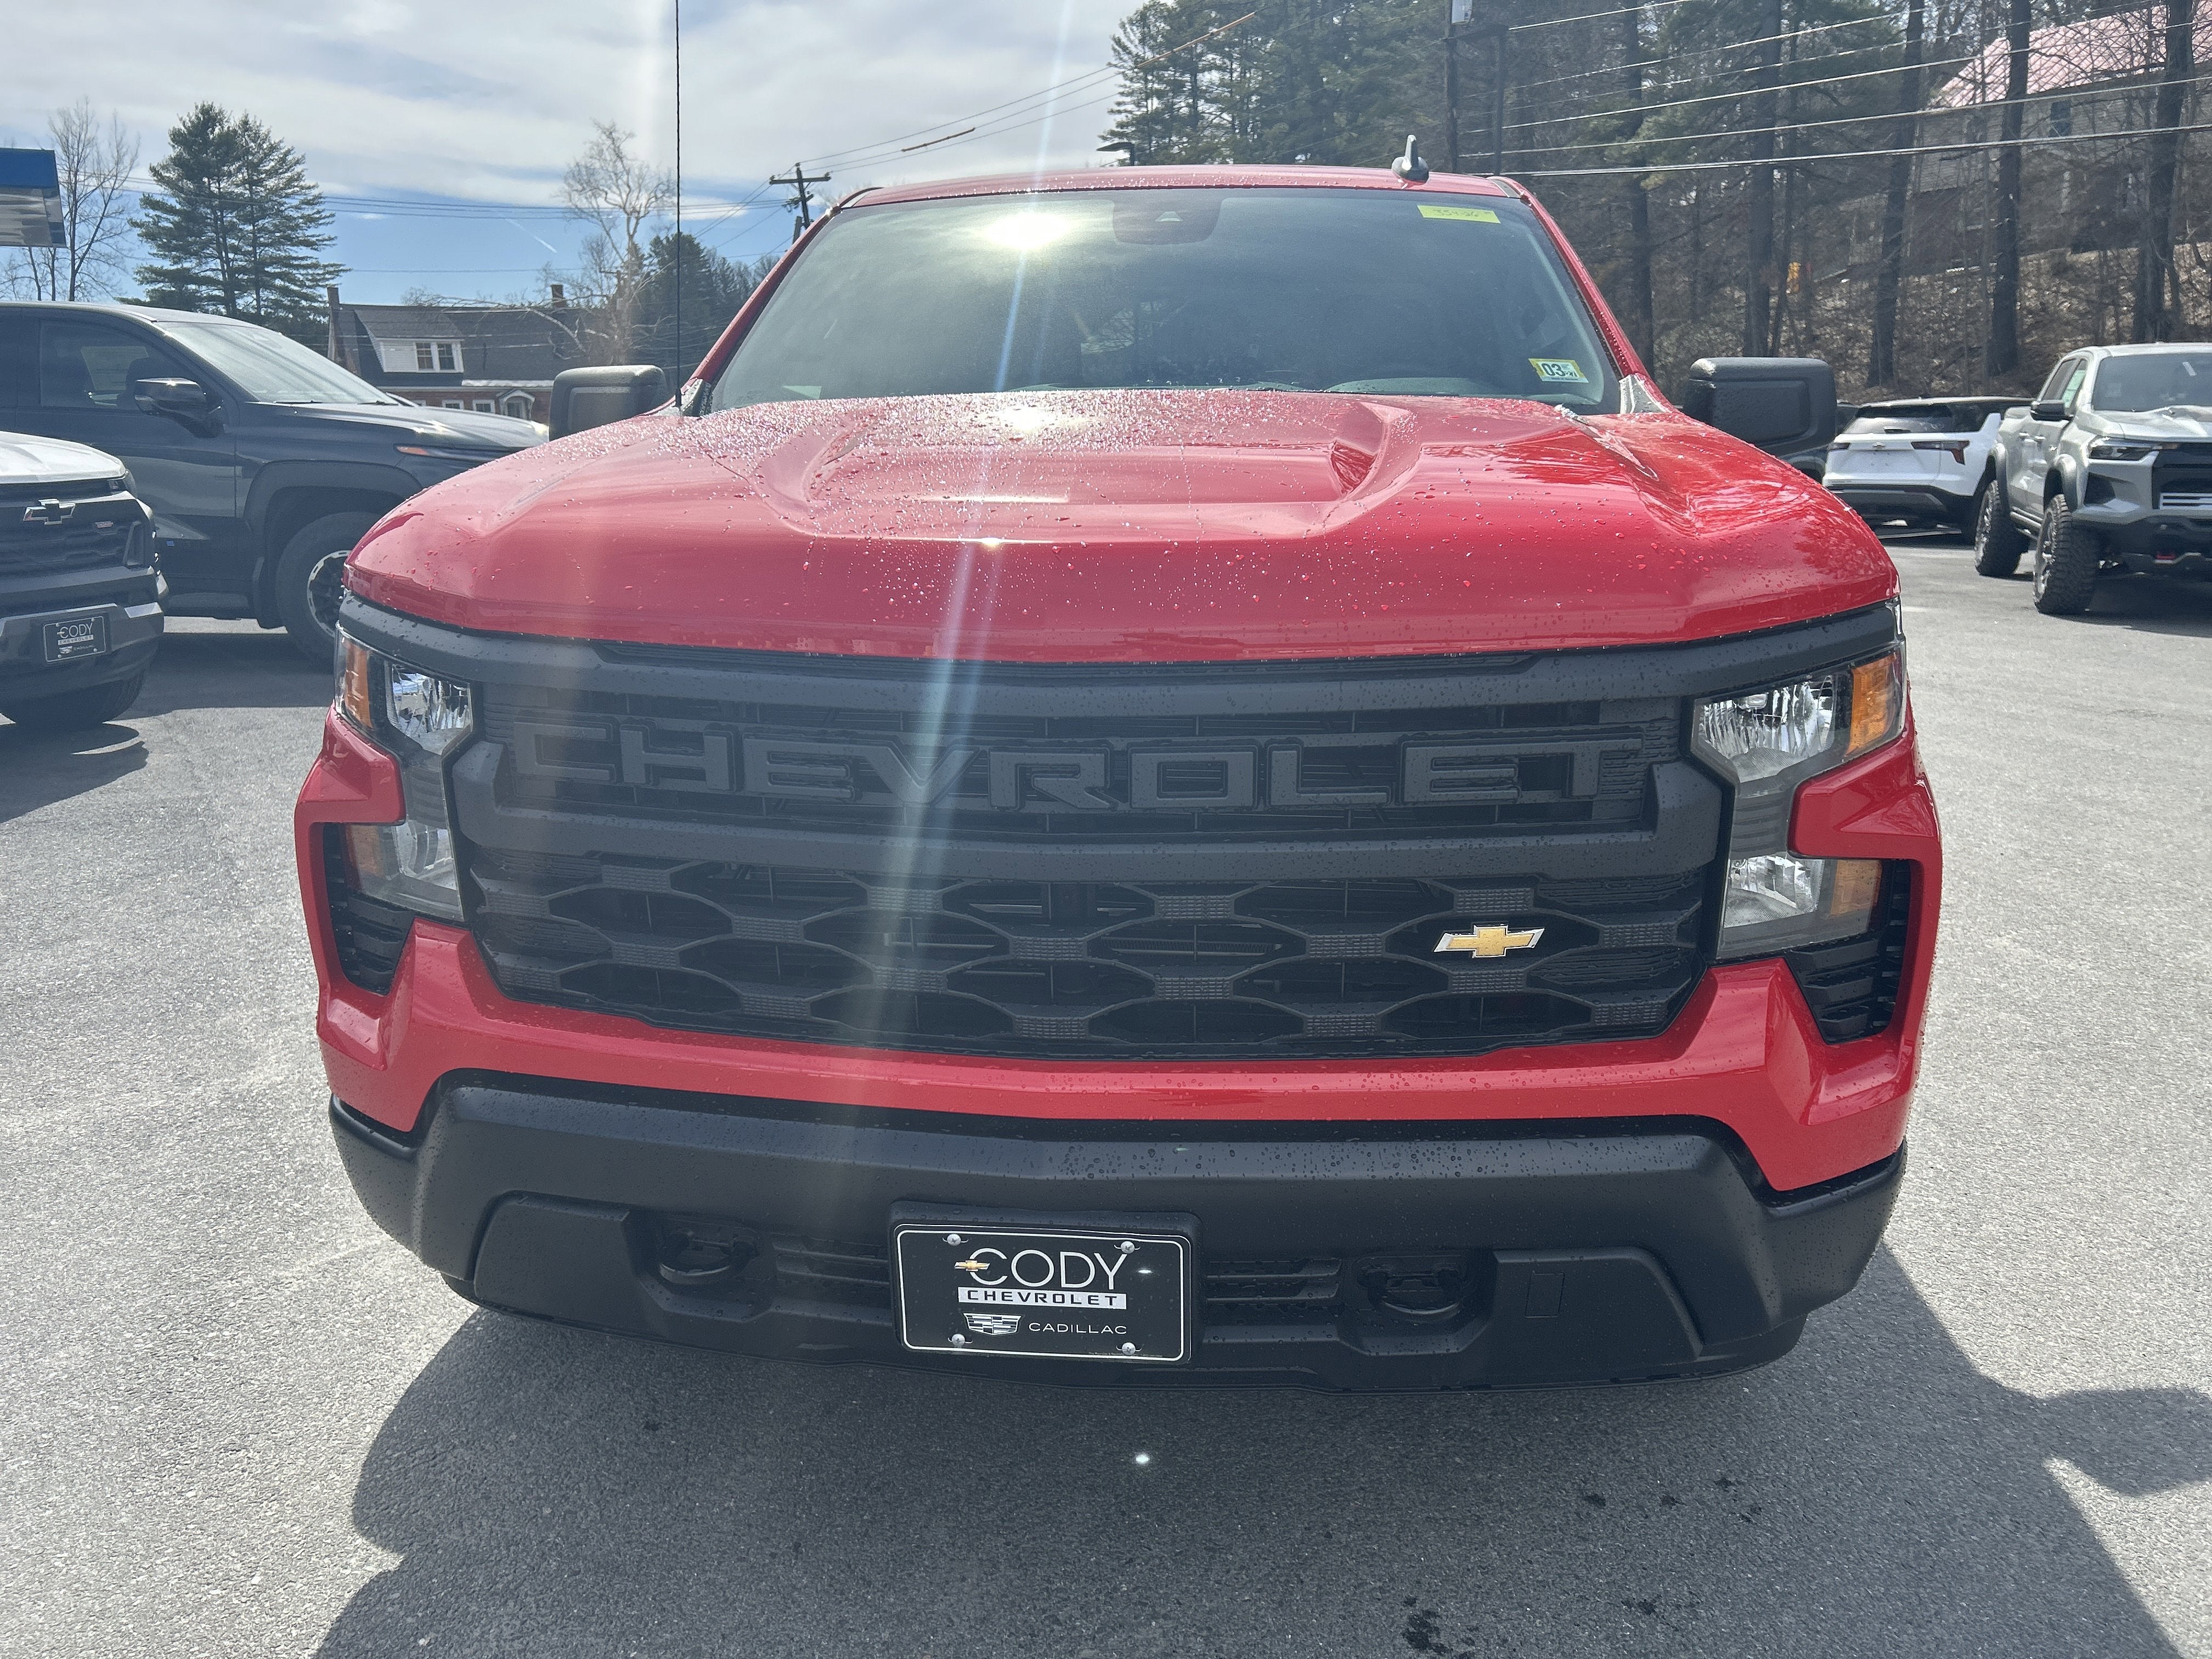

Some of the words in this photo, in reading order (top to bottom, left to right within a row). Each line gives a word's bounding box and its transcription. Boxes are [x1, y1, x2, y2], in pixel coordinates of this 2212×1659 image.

[1541, 363, 1566, 376] 03
[60, 623, 93, 639] CODY
[513, 720, 1643, 810] CHEVROLET
[969, 1248, 1127, 1290] CODY
[967, 1290, 1117, 1306] CHEVROLET
[1029, 1322, 1127, 1334] CADILLAC
